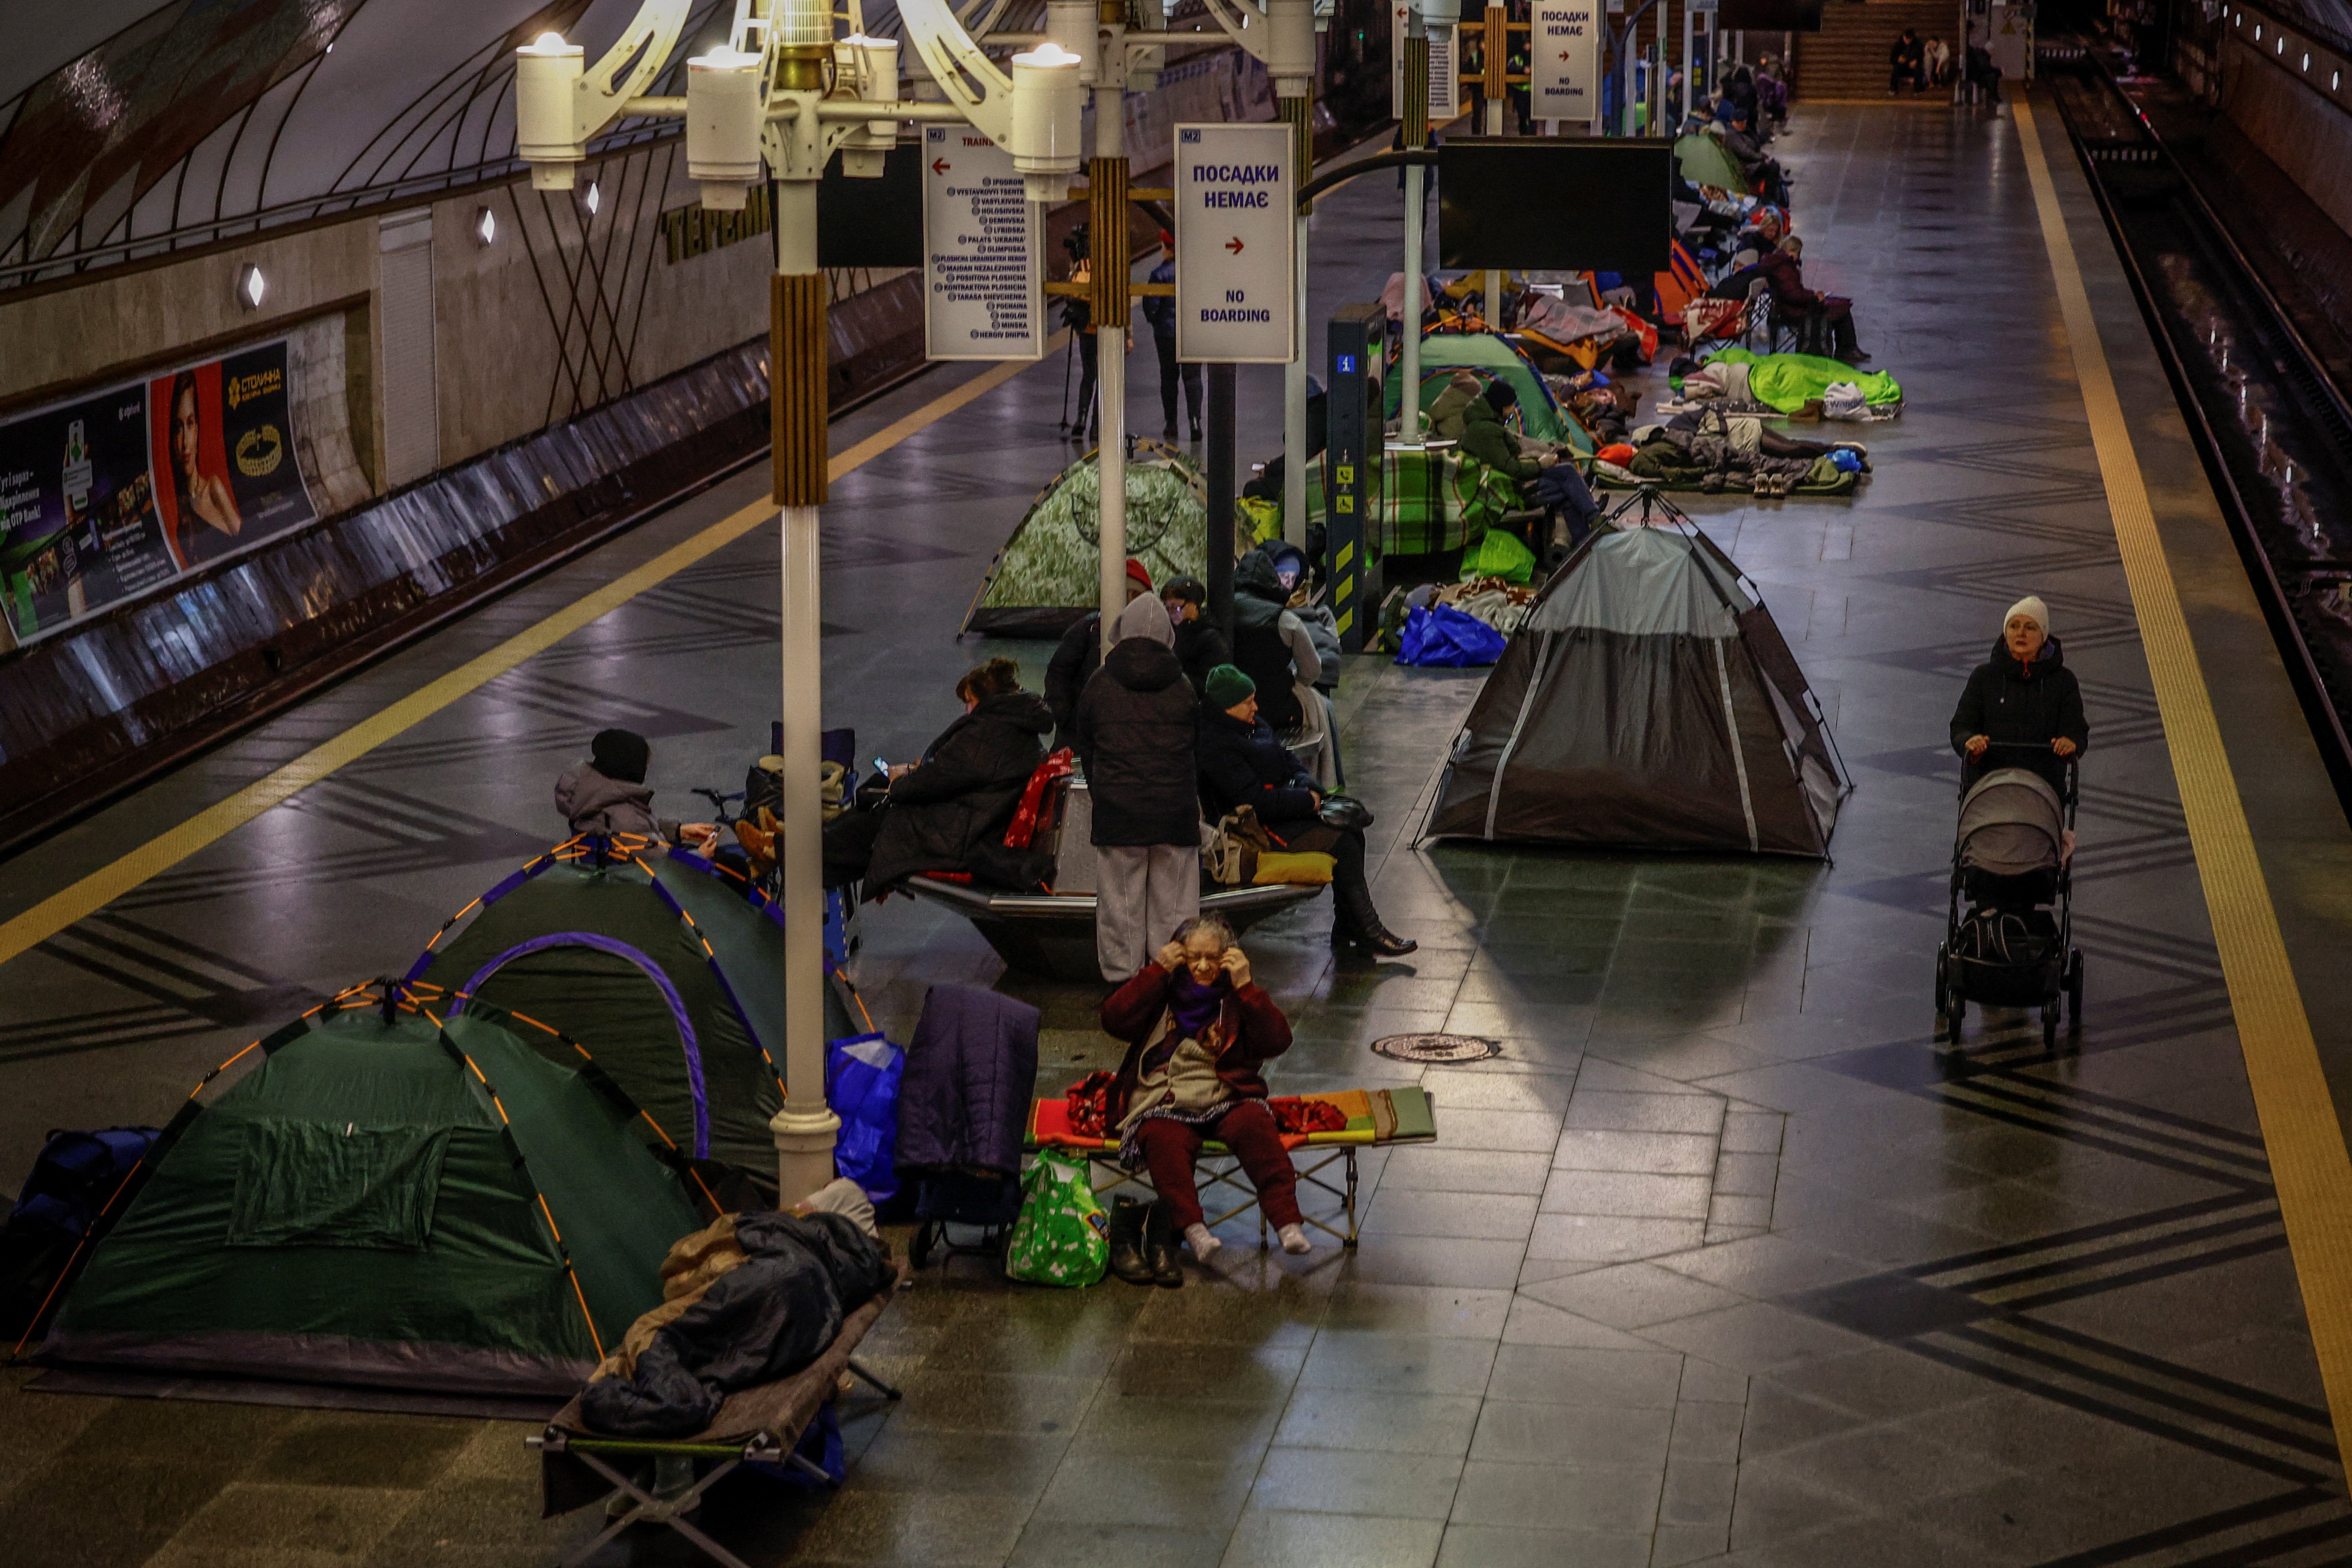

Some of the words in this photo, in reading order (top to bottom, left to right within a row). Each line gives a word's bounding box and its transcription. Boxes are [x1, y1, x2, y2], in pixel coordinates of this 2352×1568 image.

[1542, 11, 1589, 23] ПОСАДКИ
[1547, 25, 1583, 36] НЕМАЄ
[1559, 77, 1570, 85] NO
[1545, 87, 1583, 96] BOARDING
[1193, 165, 1279, 185] ПОСАДКИ
[1205, 191, 1269, 208] НЕМАЄ
[1226, 289, 1244, 303] NO
[1201, 309, 1270, 322] BOARDING
